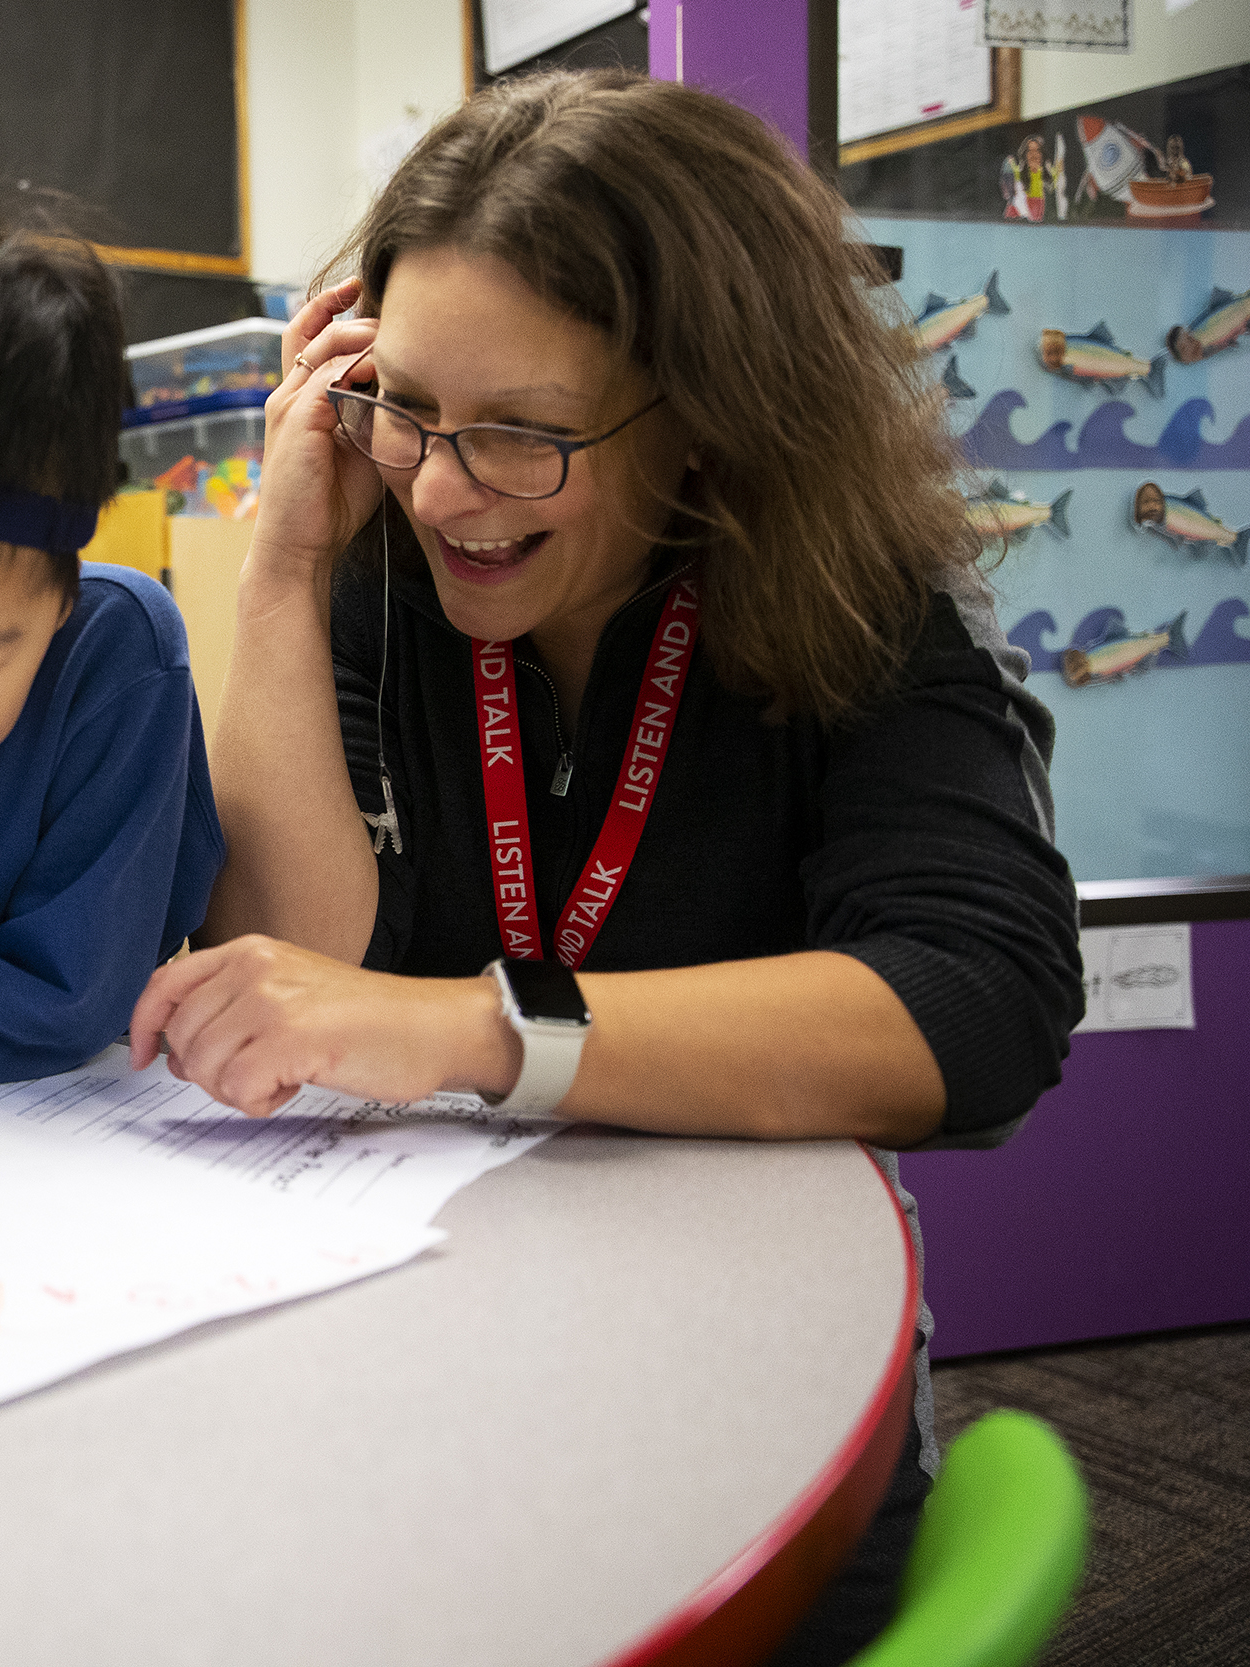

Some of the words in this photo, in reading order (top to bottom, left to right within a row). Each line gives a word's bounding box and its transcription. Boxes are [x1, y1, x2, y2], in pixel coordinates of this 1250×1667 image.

[478, 639, 507, 680] ND
[619, 702, 672, 812] LISTEN
[650, 620, 691, 698] AND
[671, 579, 699, 612] TA
[482, 686, 514, 768] TALK
[492, 819, 529, 922] LISTEN
[566, 859, 623, 929] TALK
